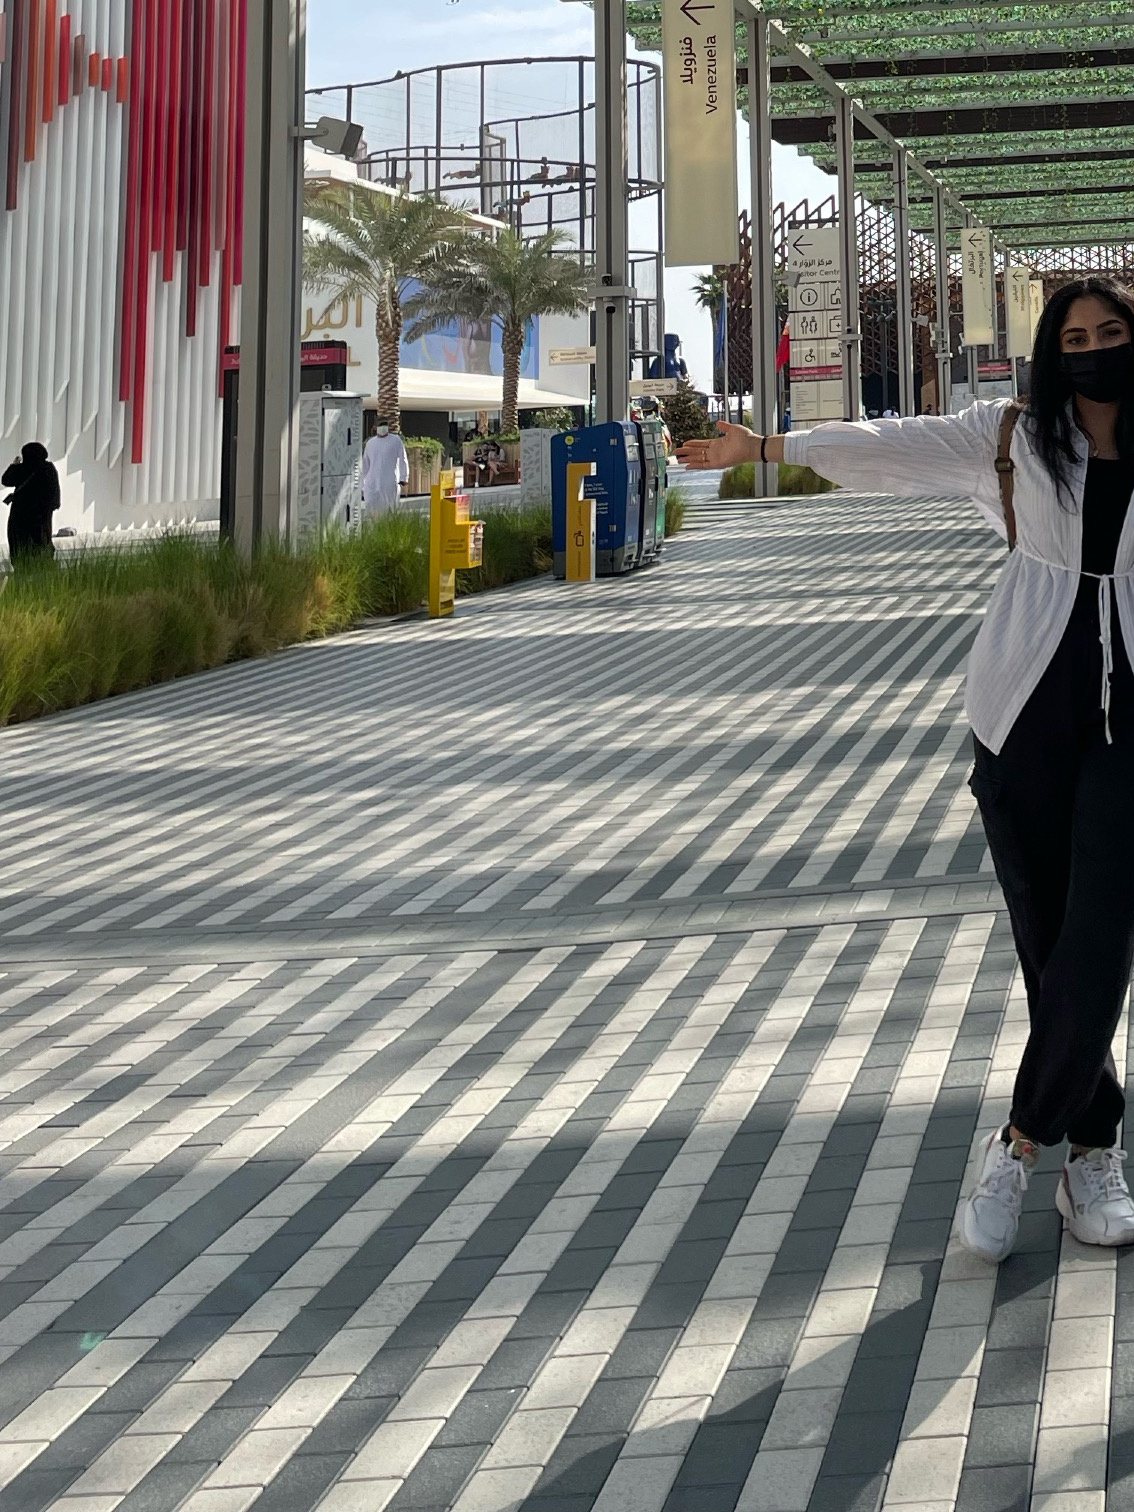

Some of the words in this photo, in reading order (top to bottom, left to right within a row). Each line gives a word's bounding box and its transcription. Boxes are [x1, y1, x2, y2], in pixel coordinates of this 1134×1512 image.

[679, 36, 697, 85] فنزويلا
[704, 35, 718, 115] Venezuela
[819, 269, 840, 277] Centr
[967, 251, 976, 275] البرتغال
